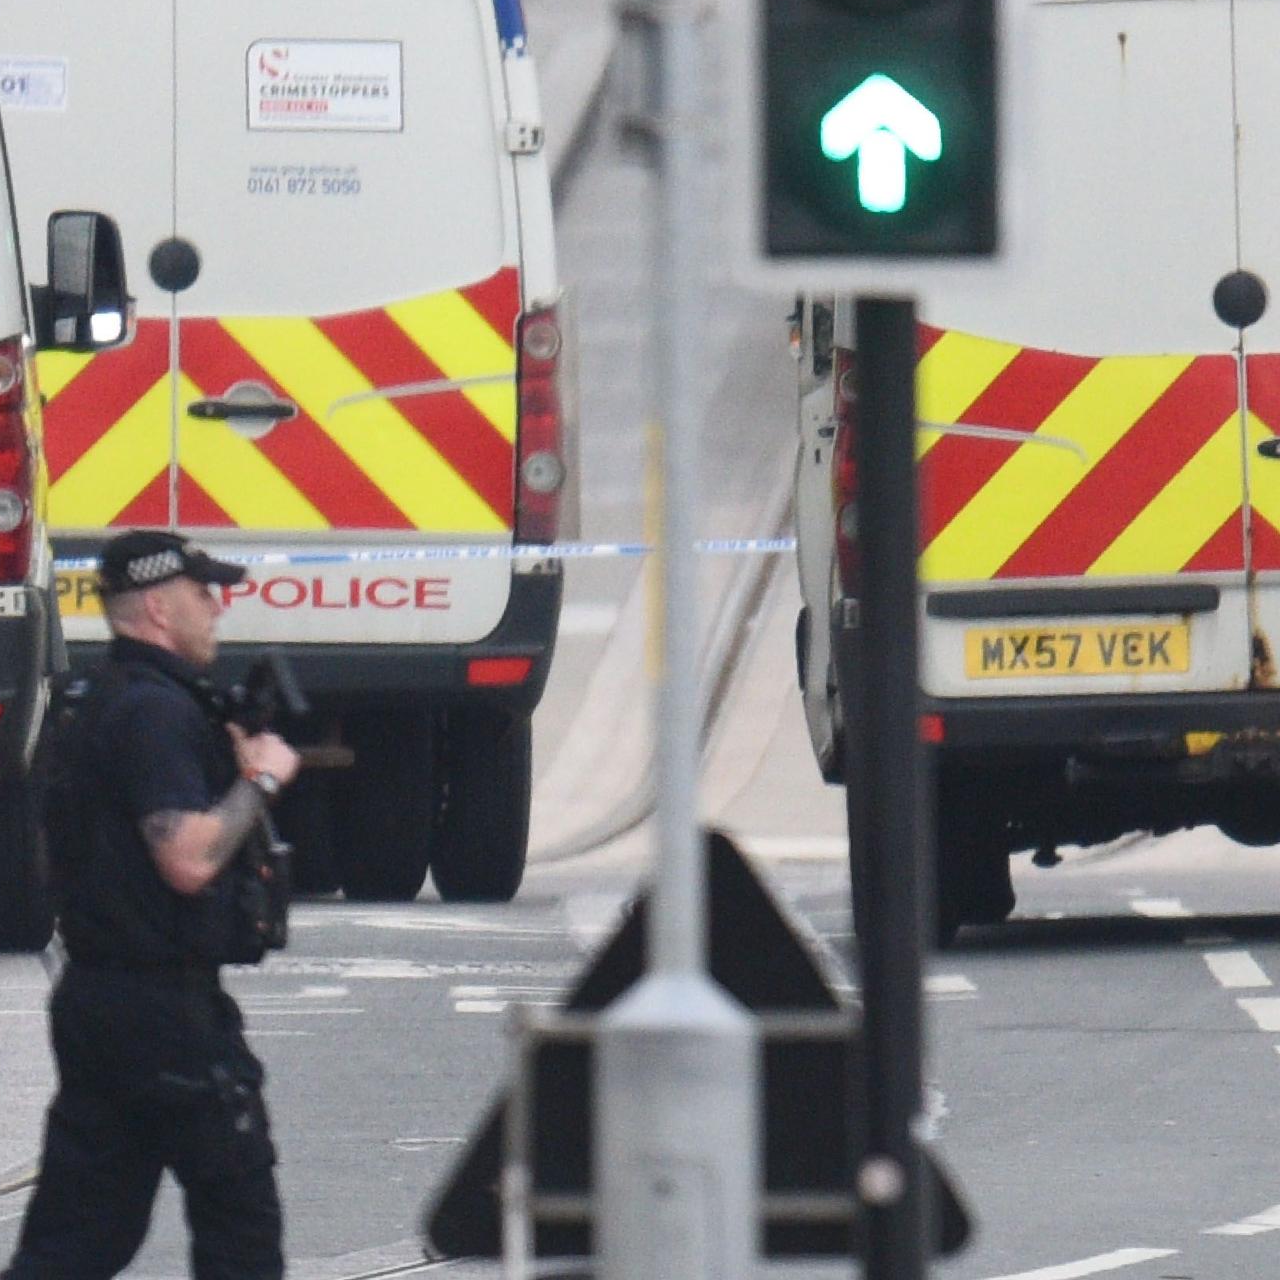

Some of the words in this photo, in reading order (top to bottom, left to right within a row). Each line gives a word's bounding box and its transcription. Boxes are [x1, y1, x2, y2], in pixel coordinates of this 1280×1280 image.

[260, 84, 390, 98] CRIMESTOPPERS
[247, 178, 279, 194] 0161
[287, 178, 316, 194] 872
[321, 178, 361, 194] 5050
[55, 575, 98, 609] PP
[222, 576, 452, 610] POLICE
[982, 633, 1083, 671] MX57
[1097, 631, 1171, 667] VEK
